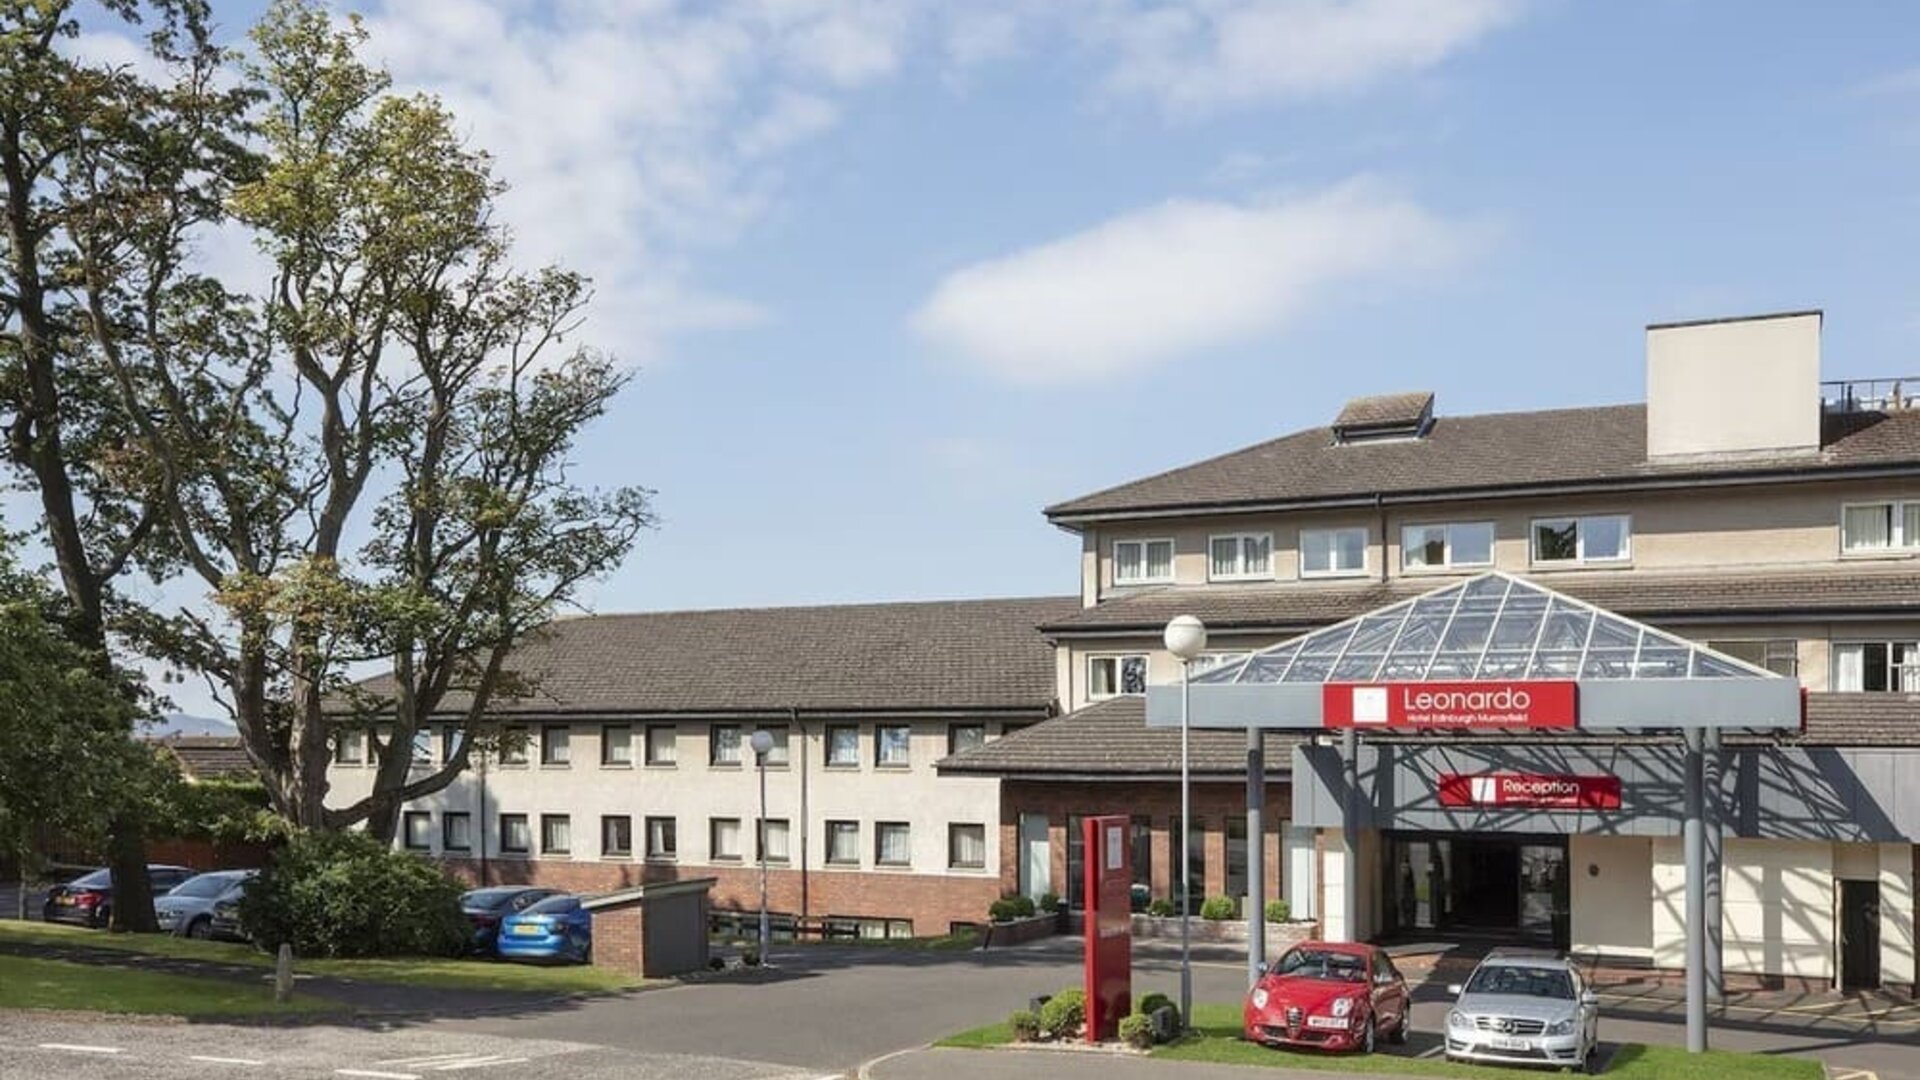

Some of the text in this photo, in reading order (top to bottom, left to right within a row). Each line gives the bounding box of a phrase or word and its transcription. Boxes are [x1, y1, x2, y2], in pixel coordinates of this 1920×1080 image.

[1404, 687, 1531, 710] Leonardo
[1406, 713, 1431, 723] Hotel
[1432, 713, 1477, 726] Edinburgh
[1502, 778, 1579, 796] Reception
